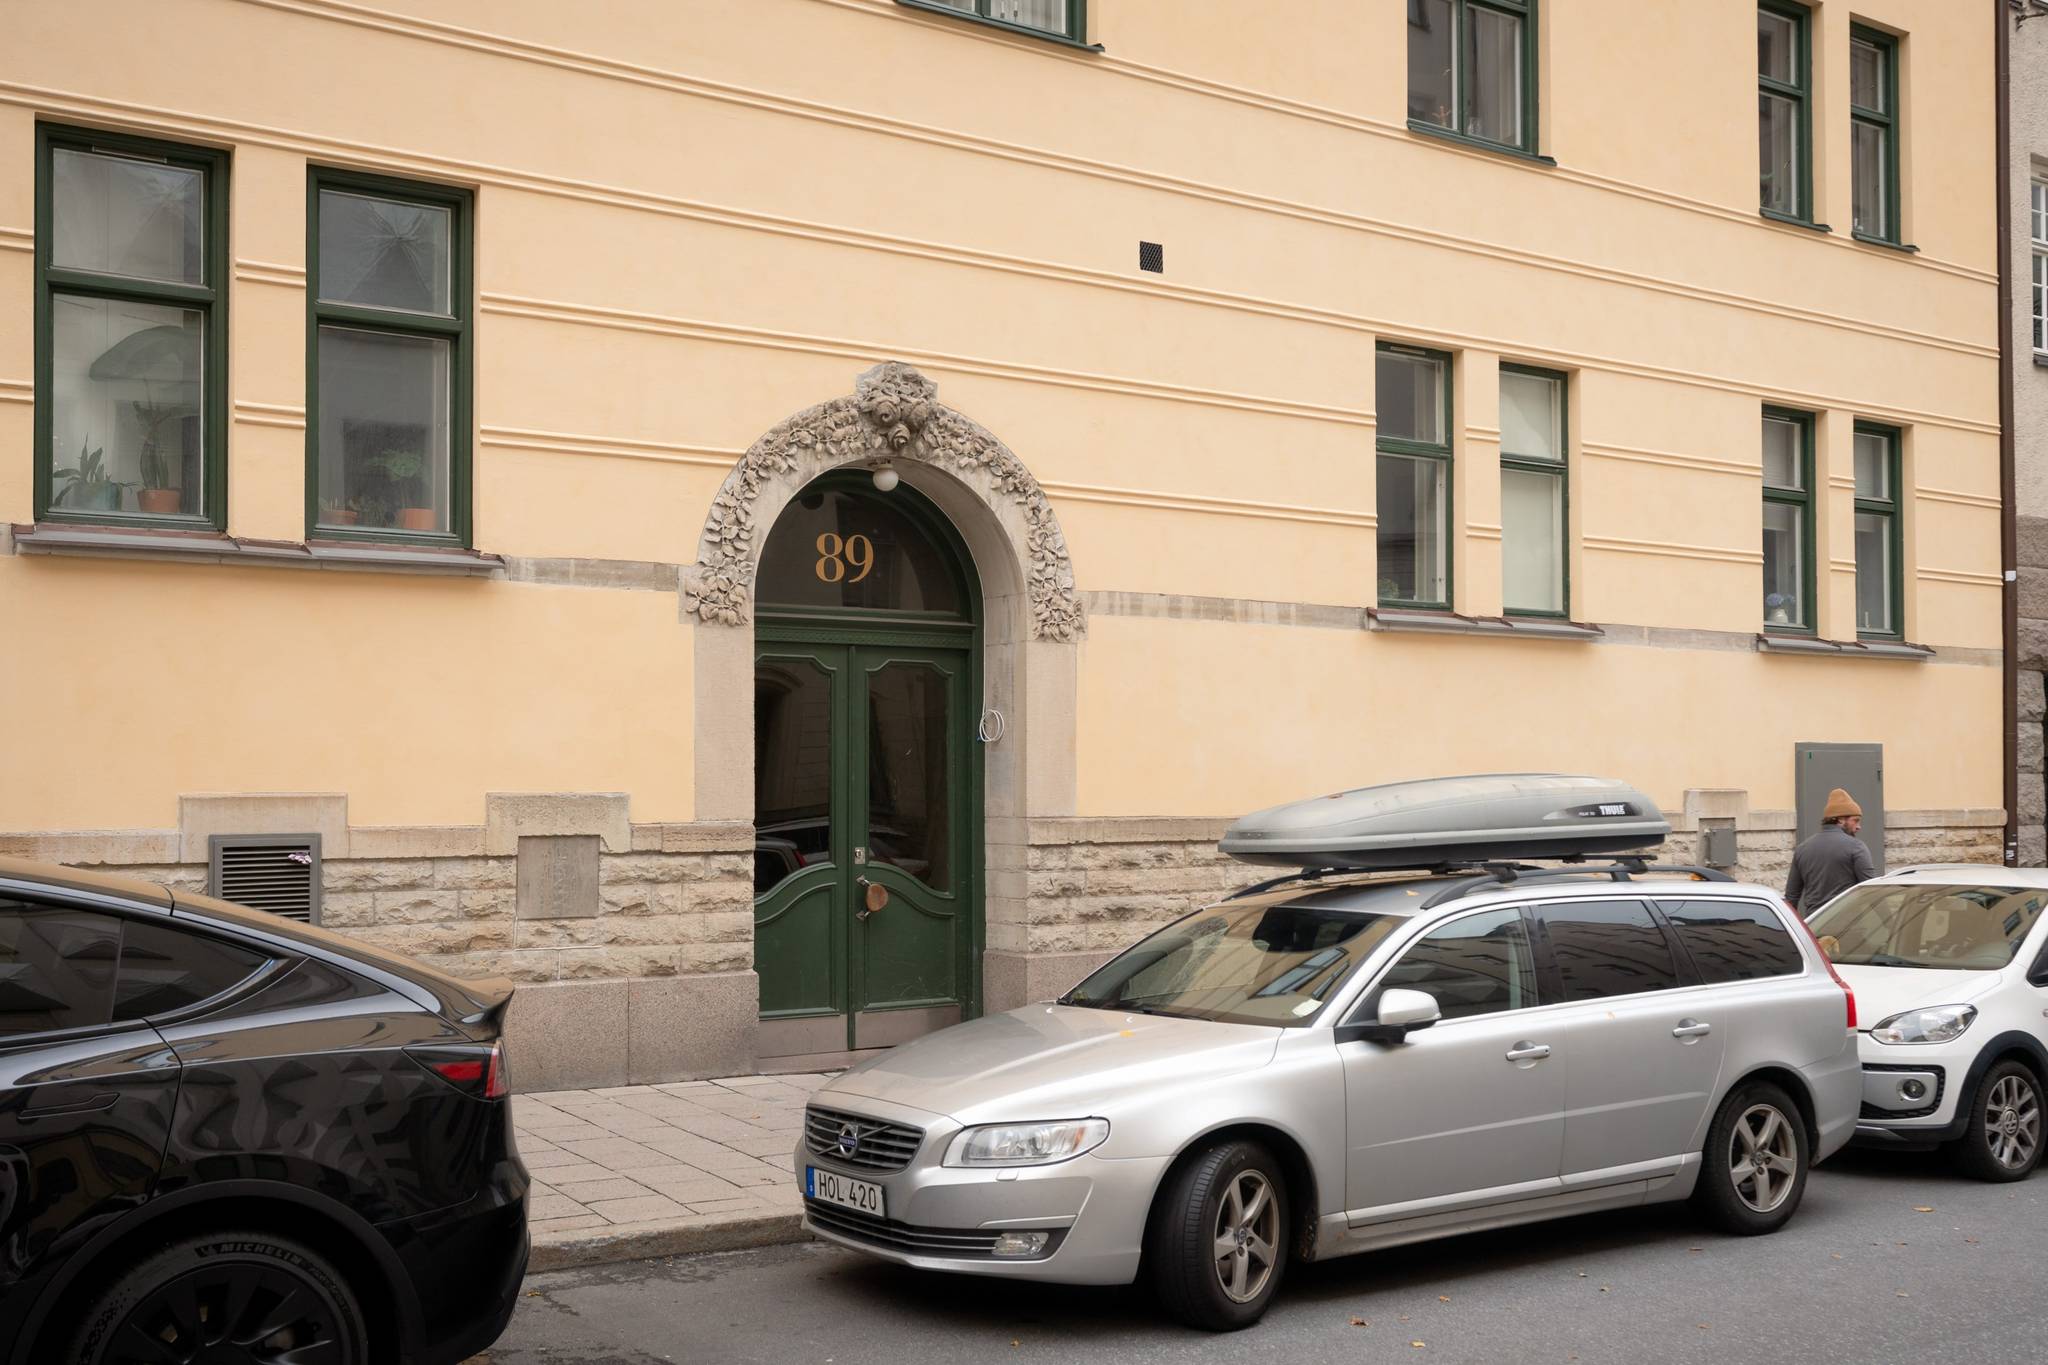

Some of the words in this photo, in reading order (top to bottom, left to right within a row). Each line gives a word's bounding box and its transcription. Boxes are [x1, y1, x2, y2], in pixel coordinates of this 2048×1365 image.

[815, 532, 874, 583] 89
[1599, 804, 1626, 816] THULE
[818, 1172, 845, 1203] HOL
[848, 1181, 877, 1211] 420
[220, 1242, 304, 1265] MICHELIN
